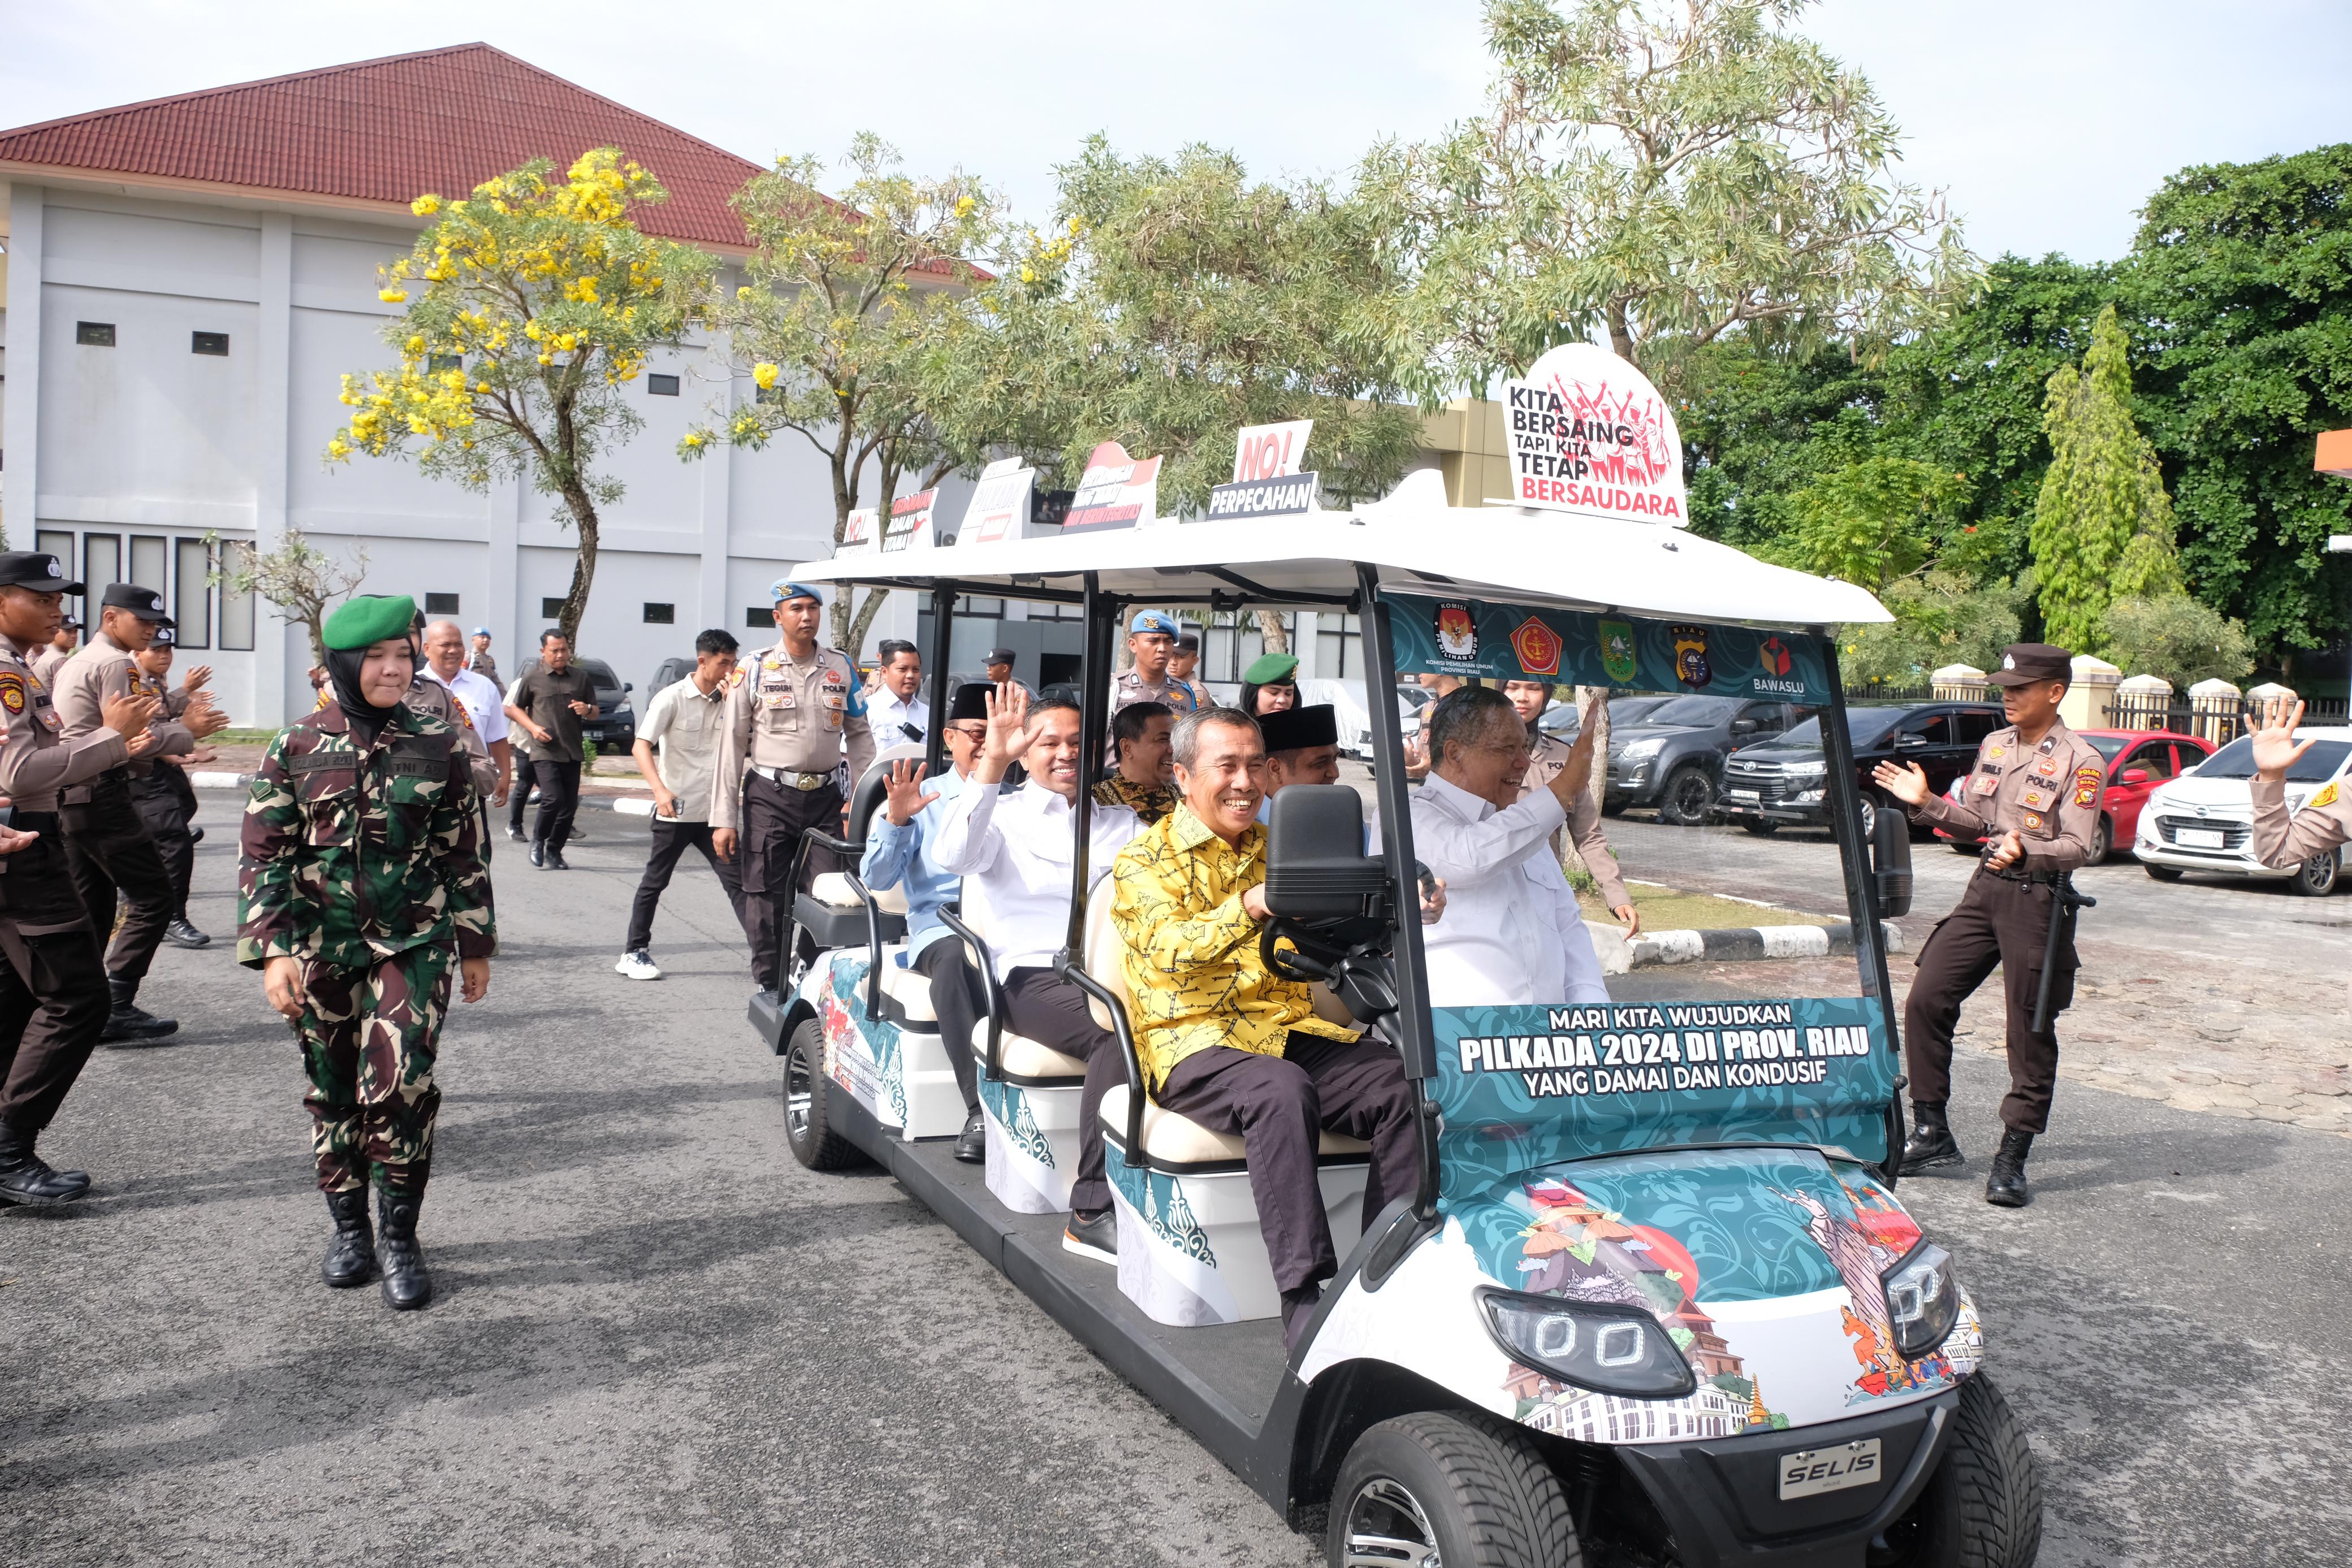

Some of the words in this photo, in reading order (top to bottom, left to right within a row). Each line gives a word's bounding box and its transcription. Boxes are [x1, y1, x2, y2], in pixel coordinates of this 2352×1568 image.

[1510, 386, 1563, 414] KITA
[1514, 409, 1633, 446] BERSAING
[1238, 430, 1292, 483] NO!
[1515, 434, 1549, 452] TAPI
[1557, 441, 1592, 458] KITA
[1518, 452, 1589, 480] TETAP
[1209, 483, 1311, 514] PERPECAHAN
[1523, 477, 1680, 518] BERSAUDARA
[887, 513, 916, 534] ADALAH
[1674, 626, 1705, 636] RIAU
[1436, 634, 1467, 660] PEMILIHAN
[1468, 637, 1478, 660] UMUM
[1753, 678, 1804, 694] BAWASLU
[411, 705, 442, 716] POLRI
[1167, 702, 1186, 712] POLRI
[394, 763, 416, 773] TNI
[2026, 774, 2058, 792] POLRI
[1549, 1009, 1609, 1030] MARI
[1614, 1008, 1666, 1028] KITA
[1668, 1005, 1791, 1026] WUJUDKAN
[1459, 1036, 1598, 1072] PILKADA
[1600, 1032, 1681, 1065] 2024
[1685, 1031, 1718, 1062] DI
[1722, 1028, 1804, 1060] PROV.
[1806, 1026, 1870, 1056] RIAU
[1524, 1072, 1590, 1097] YANG
[1594, 1067, 1669, 1093] DAMAI
[1674, 1064, 1720, 1089] DAN
[1725, 1060, 1827, 1087] KONDUSIF
[1784, 1453, 1877, 1485] SELIS
